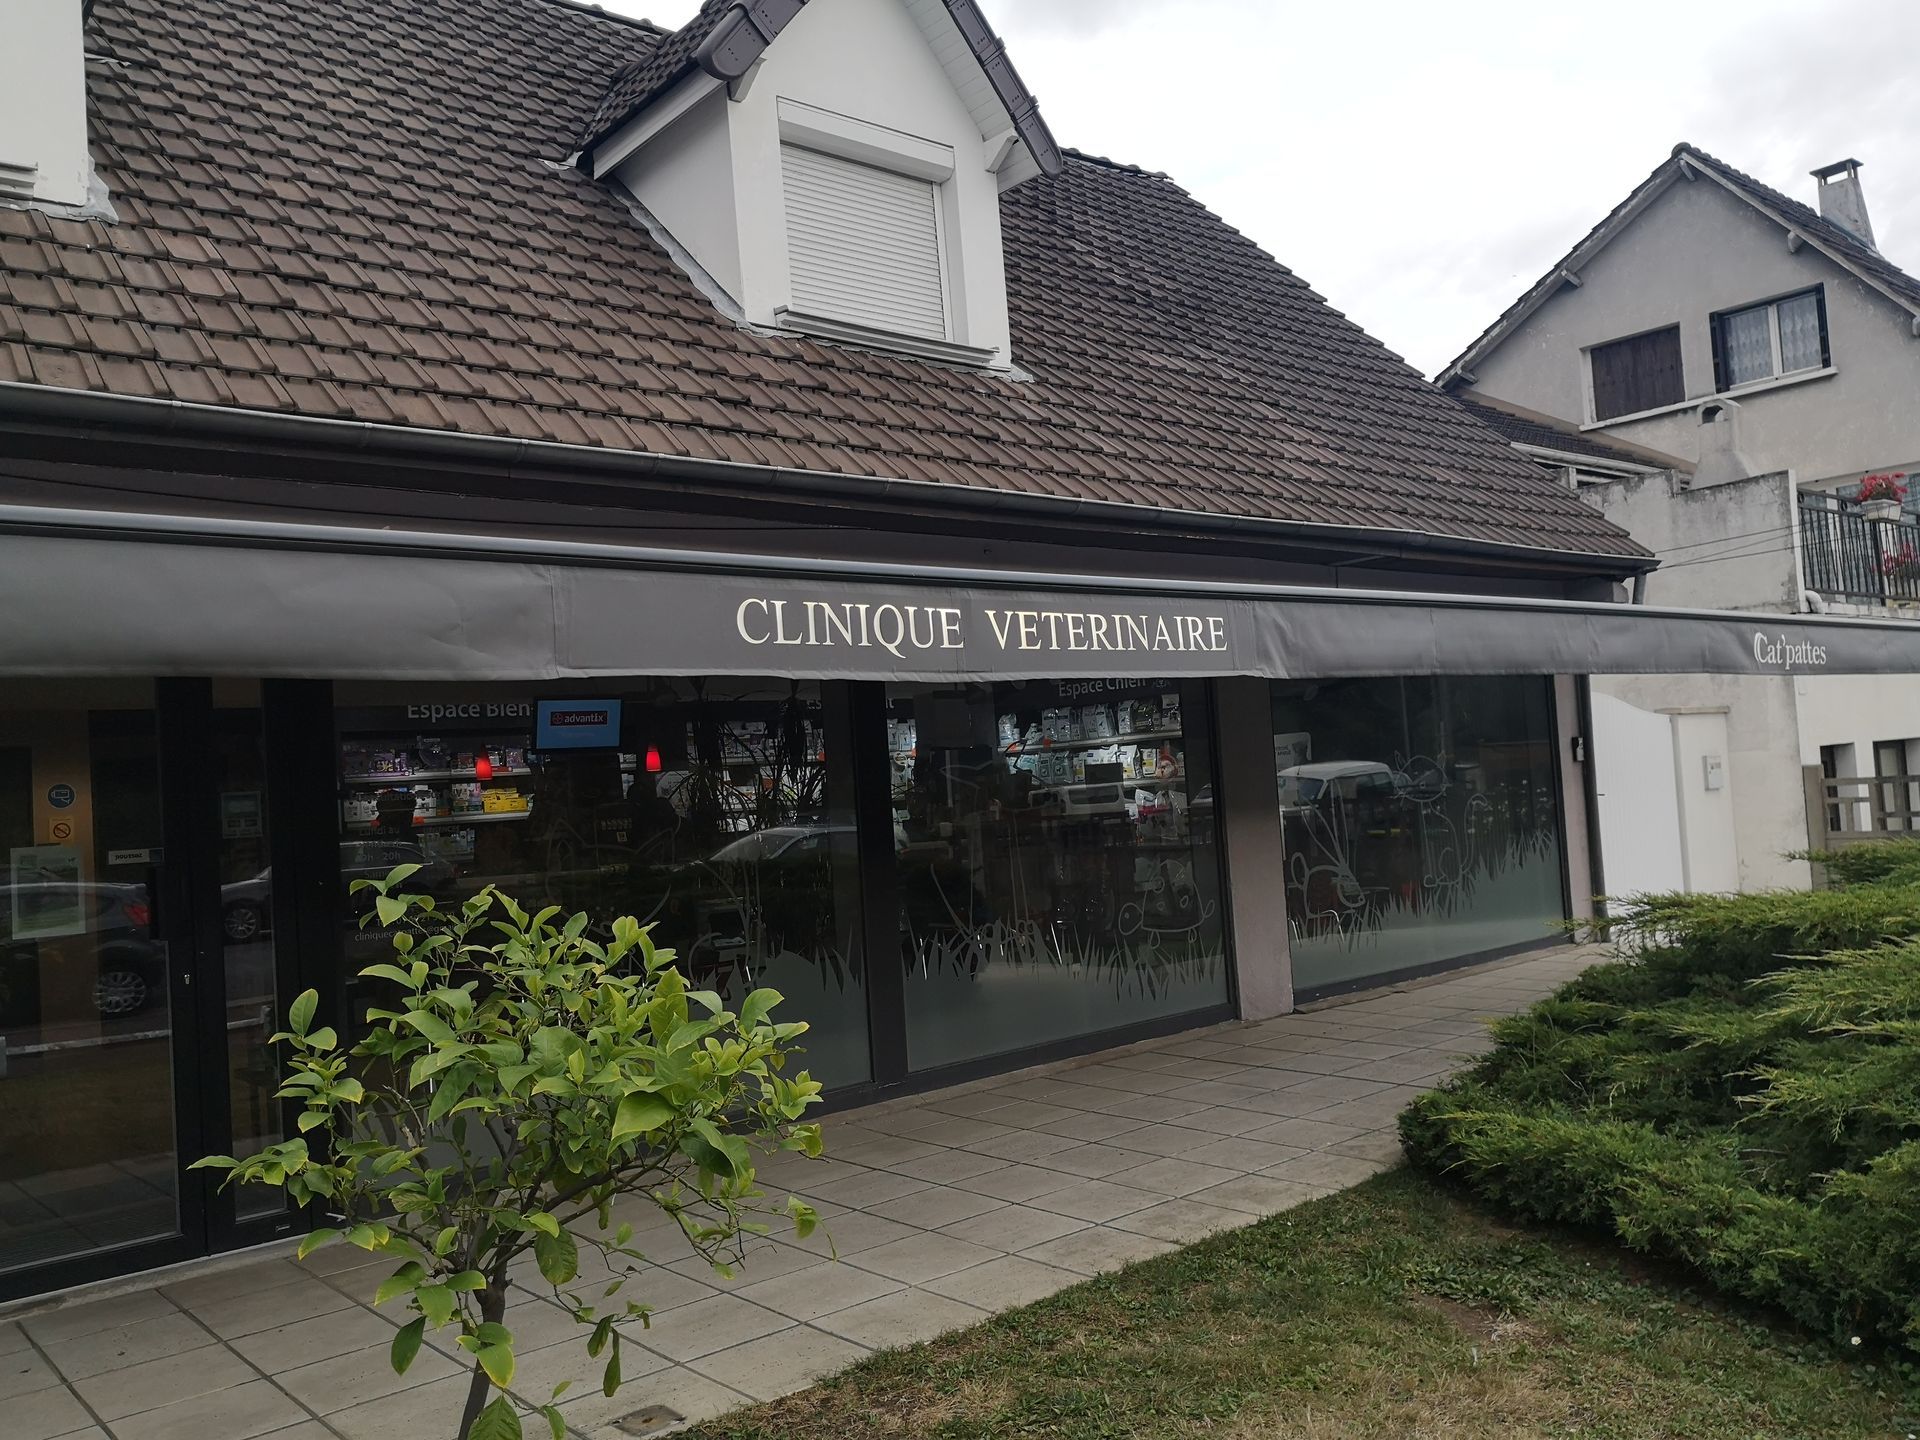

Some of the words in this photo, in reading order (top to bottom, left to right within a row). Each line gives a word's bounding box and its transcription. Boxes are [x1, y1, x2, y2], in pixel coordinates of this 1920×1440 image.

[736, 598, 964, 658] CLINIQUE
[984, 609, 1228, 652] VETERINAIRE
[1059, 682, 1103, 699] Espace
[407, 704, 480, 723] Espace
